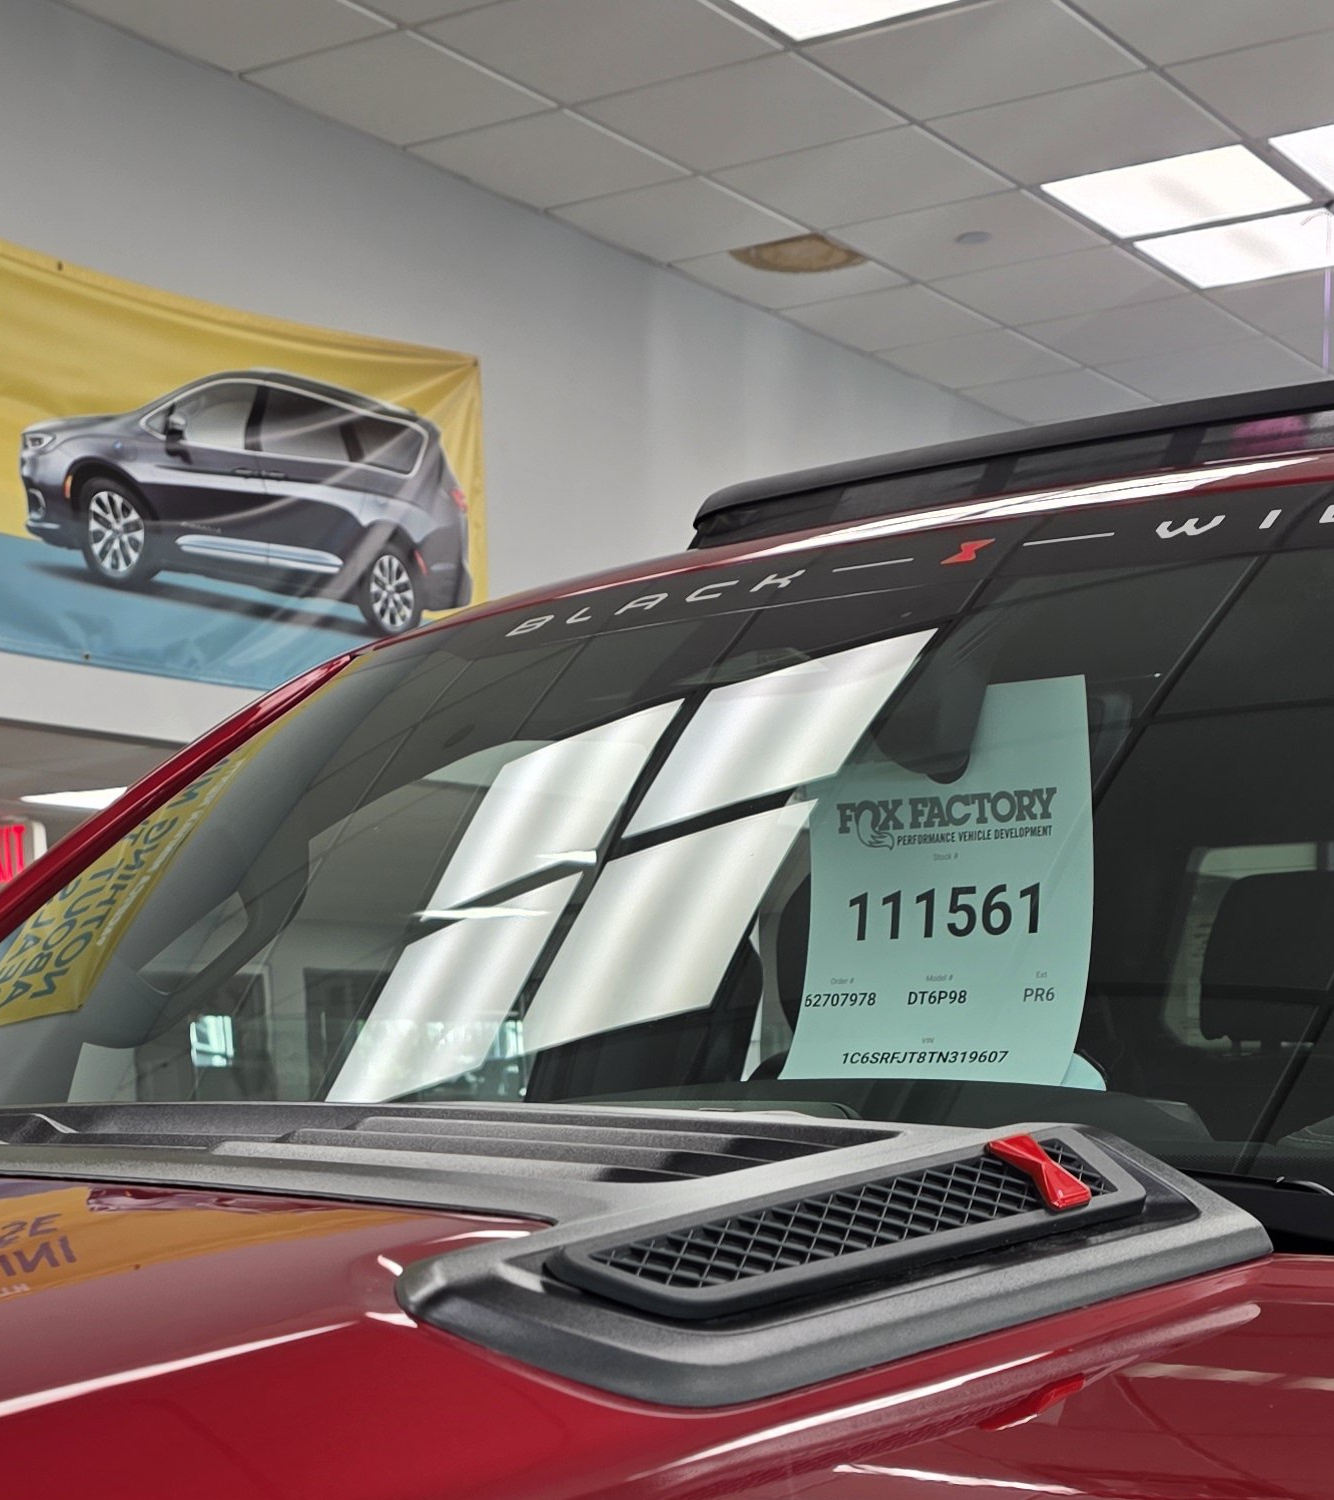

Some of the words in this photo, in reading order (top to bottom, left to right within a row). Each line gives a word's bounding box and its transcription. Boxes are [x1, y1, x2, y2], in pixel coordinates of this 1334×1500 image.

[505, 569, 806, 637] BLACK
[836, 799, 905, 836] FOX
[908, 787, 1058, 828] FACTORY
[897, 832, 956, 846] PERFORMANCE
[958, 828, 992, 842] VEHICLE
[994, 825, 1053, 840] DEVELOPMENT
[848, 882, 1042, 942] 111561
[804, 992, 877, 1007] 62707978
[907, 990, 967, 1005] DT6P98
[1023, 987, 1055, 1002] PR6
[841, 1051, 1009, 1064] 1C6SRFJT8TN319607
